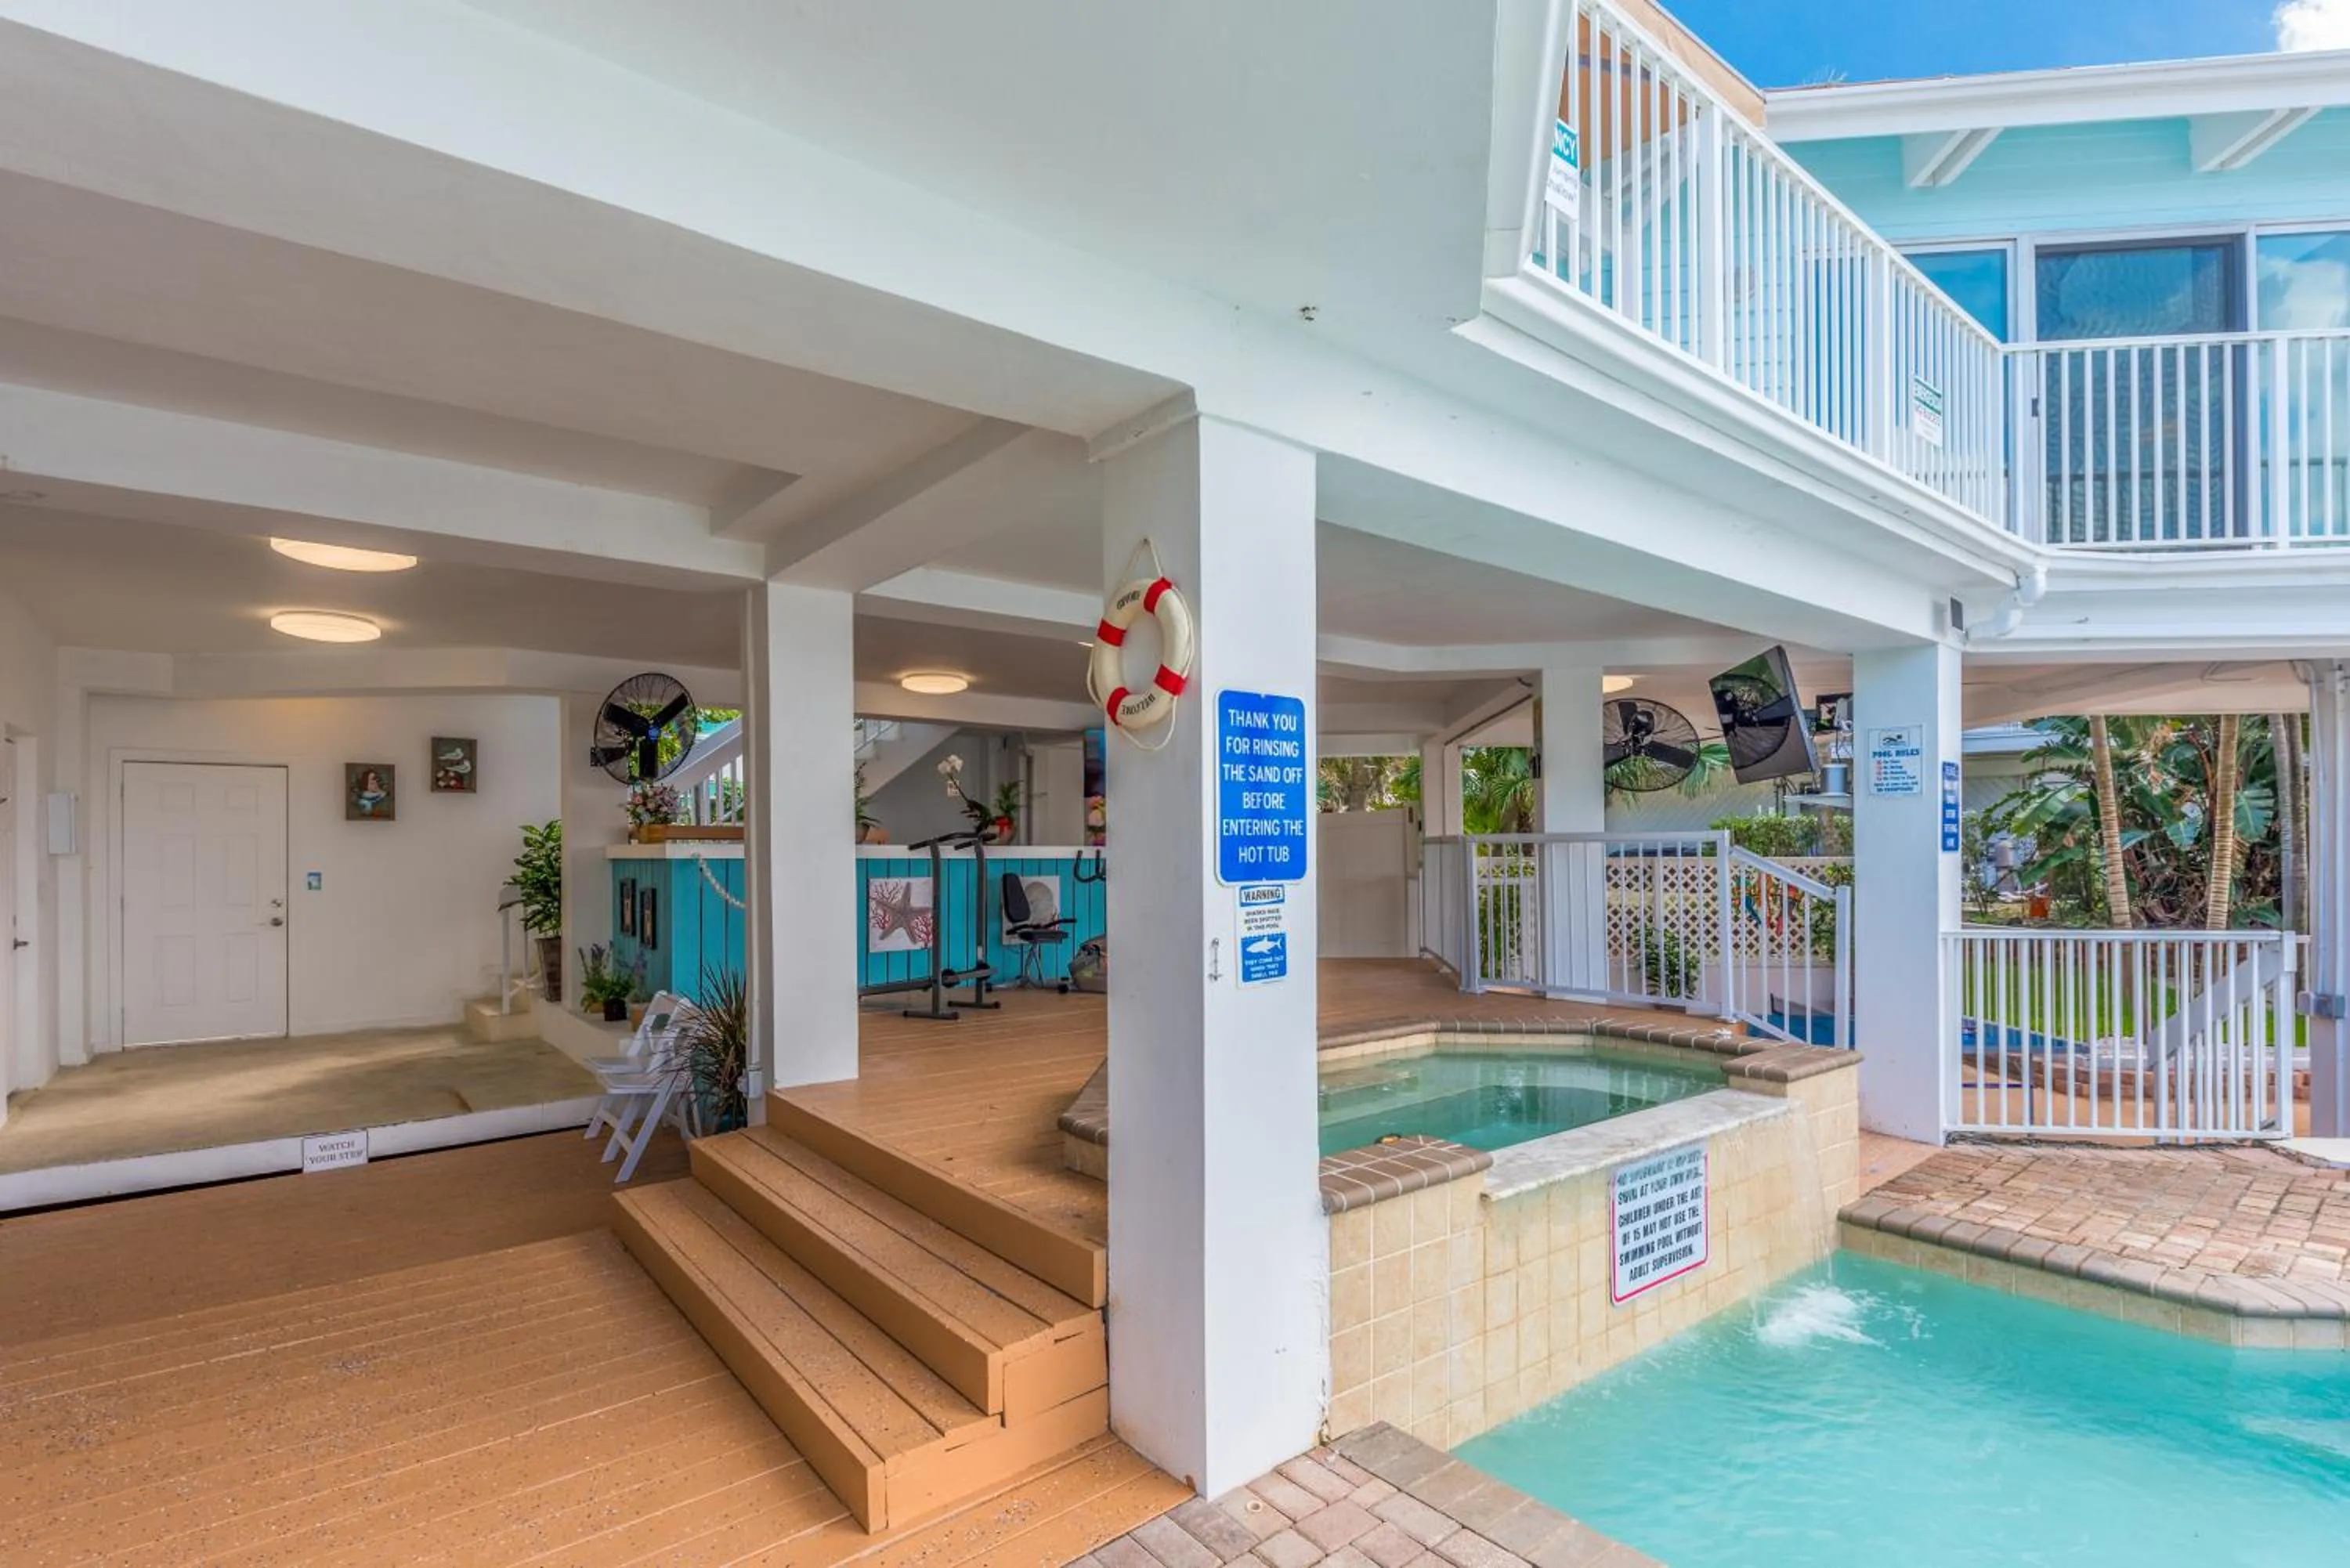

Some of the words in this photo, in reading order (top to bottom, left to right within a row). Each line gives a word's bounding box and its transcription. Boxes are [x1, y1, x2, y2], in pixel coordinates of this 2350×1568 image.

[1228, 709, 1270, 729] THANK
[1272, 714, 1296, 731] YOU
[1226, 736, 1250, 754] FOR
[1253, 739, 1300, 757] RINSING
[1222, 764, 1246, 782] THE
[1249, 765, 1281, 783] SAND
[1282, 767, 1303, 784] OFF
[1242, 792, 1285, 809] BEFORE
[1222, 818, 1280, 836] ENTERING
[1283, 820, 1303, 836] THE
[1238, 846, 1264, 863] HOT
[1267, 846, 1289, 862] TUB
[1244, 888, 1280, 901] WARNING
[319, 1140, 355, 1152] WATCH
[309, 1154, 336, 1164] YOUR
[338, 1150, 363, 1160] STEP
[1618, 1205, 1650, 1229] CHILDREN
[1654, 1197, 1674, 1216] UNDER
[1677, 1190, 1688, 1207] THE
[1643, 1222, 1657, 1239] MAY
[1659, 1215, 1672, 1231] NOT
[1619, 1241, 1655, 1266] SWIMMING
[1657, 1234, 1673, 1252] POOL
[1676, 1221, 1702, 1243] WITHOUT
[1629, 1263, 1650, 1282] ADULT
